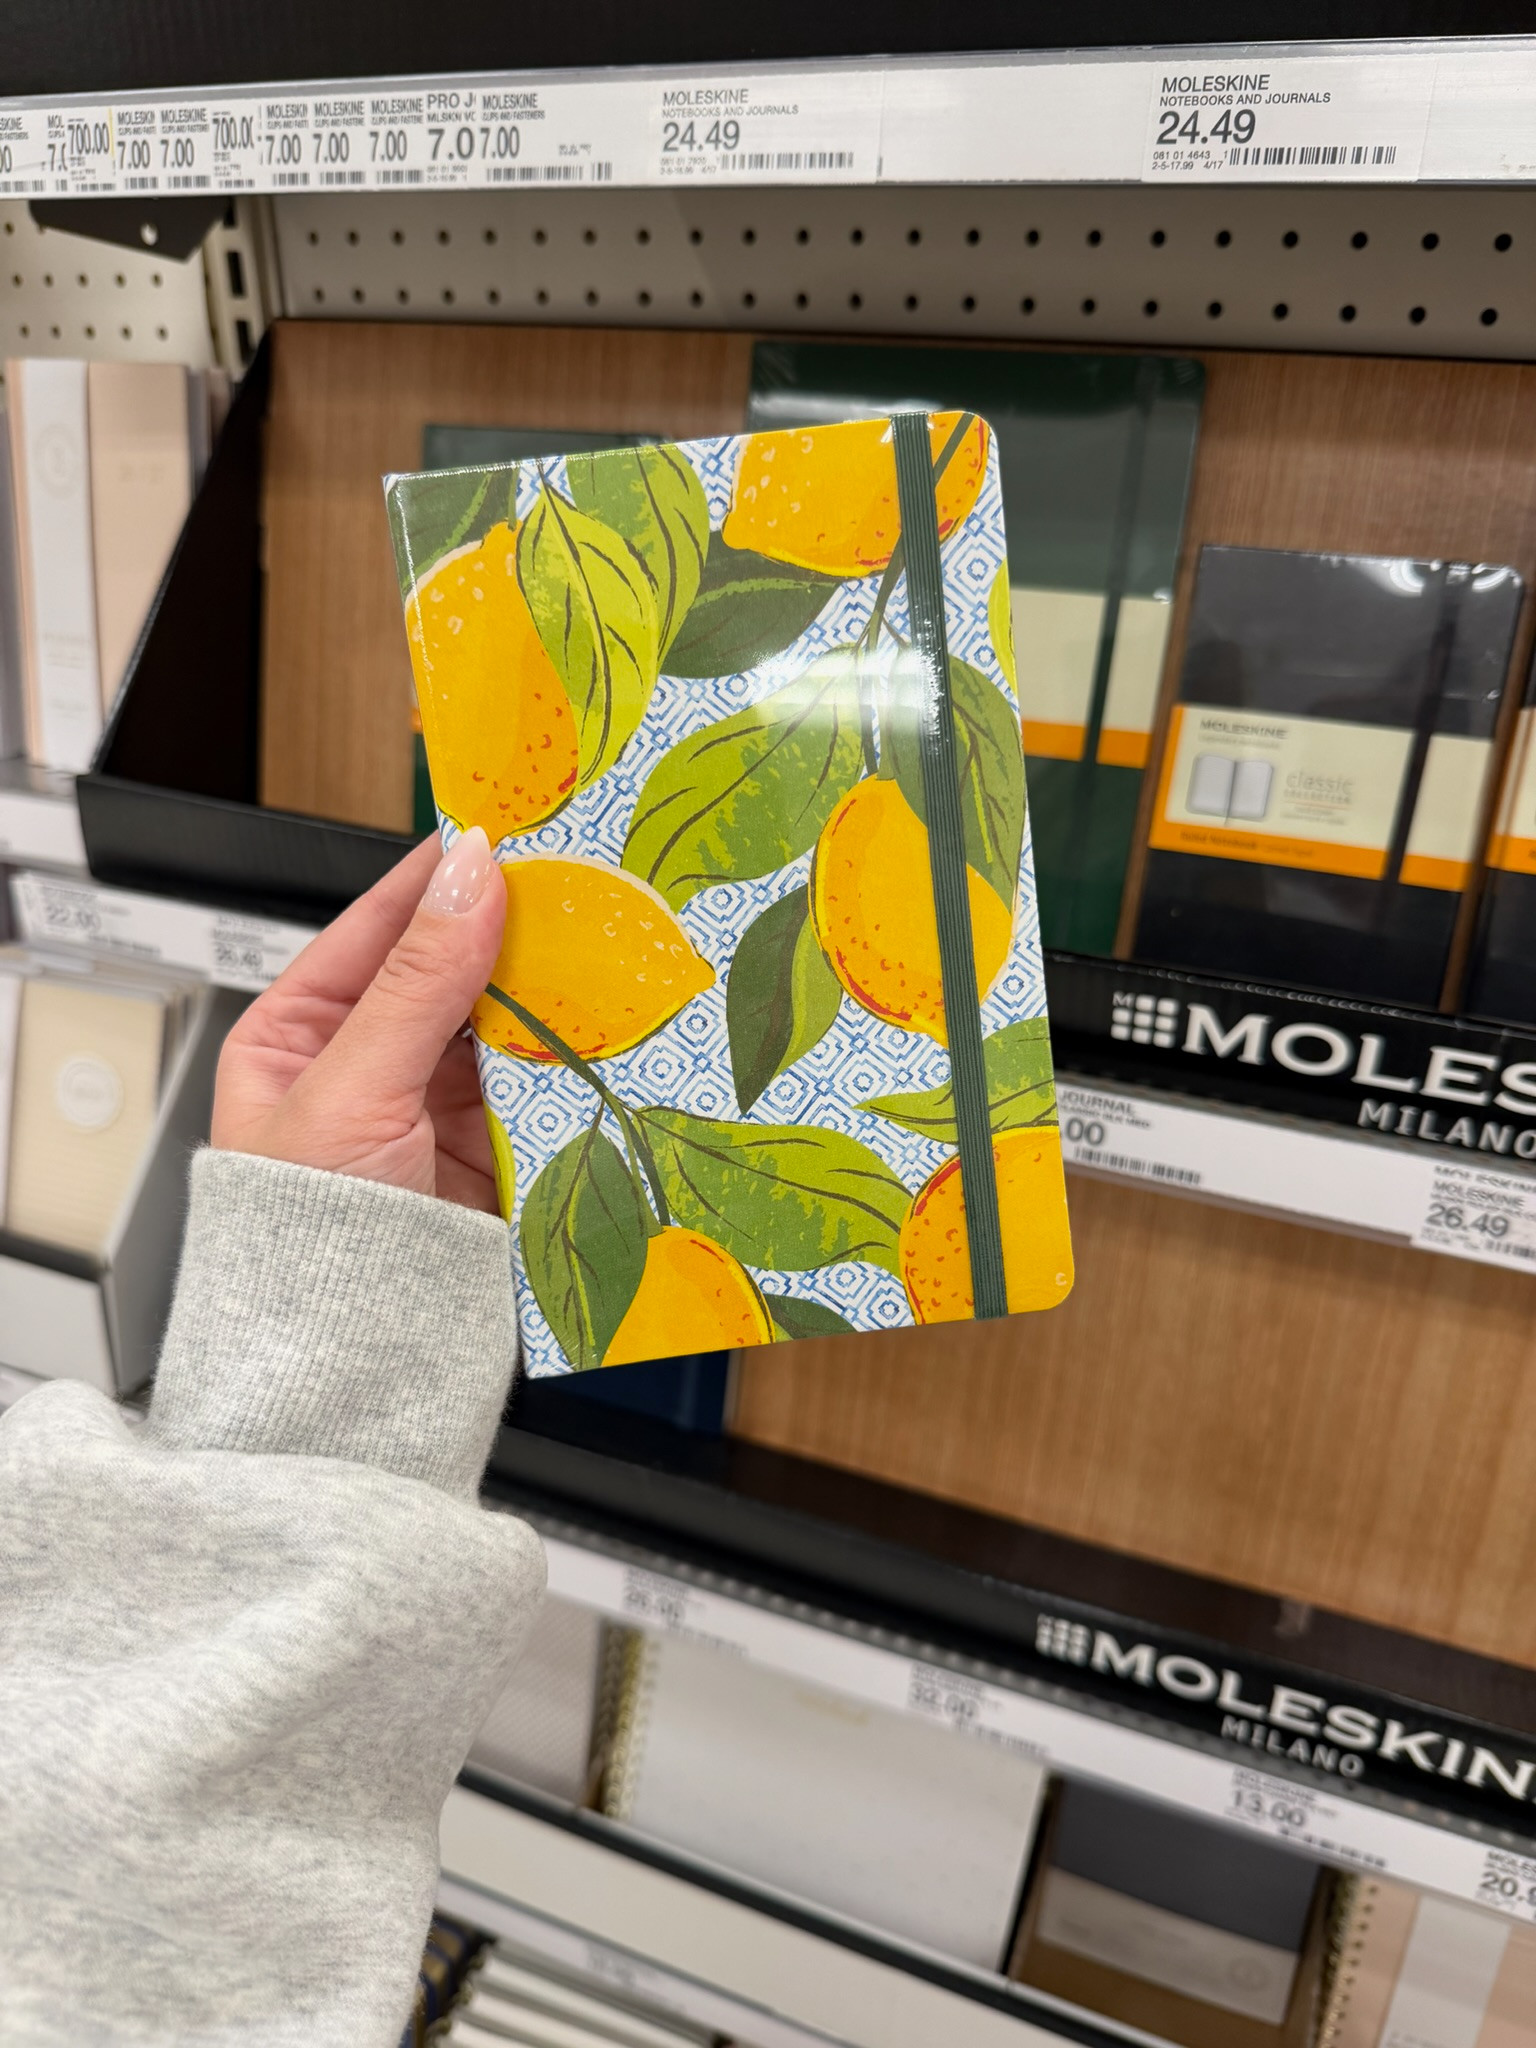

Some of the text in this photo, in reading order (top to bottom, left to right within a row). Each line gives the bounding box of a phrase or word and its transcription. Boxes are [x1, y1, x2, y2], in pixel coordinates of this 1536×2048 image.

[663, 88, 749, 107] MOLESKINE
[1162, 74, 1270, 93] MOLESKINE
[314, 100, 365, 117] MOLESKINE
[371, 98, 424, 115] MOLESKINE
[427, 91, 476, 109] PRO J
[482, 92, 538, 110] MOLESKINE
[662, 104, 799, 119] NOTEBOOKS AND JOURNALS
[1160, 92, 1331, 107] NOTEBOOKS AND JOURNALS
[160, 107, 207, 124] MOLESKINE
[1156, 108, 1256, 145] 24.49
[265, 133, 302, 165] 7.00
[313, 131, 350, 163] 7.00
[369, 129, 408, 162] 7.00
[428, 126, 475, 160] 7.0
[480, 125, 520, 159] 7.00
[663, 120, 740, 152] 24.49
[117, 139, 150, 170] 7.00
[160, 138, 194, 168] 7.00
[1152, 160, 1223, 170] 2-5-17.99 4/17
[1153, 151, 1170, 160] 081
[1173, 151, 1184, 160] 01
[1187, 150, 1211, 160] 4643
[1357, 1098, 1536, 1160] MILANO
[1425, 1202, 1508, 1238] 26.49
[1091, 1630, 1536, 1799] MOLESKIN
[1221, 1714, 1366, 1779] MILANO
